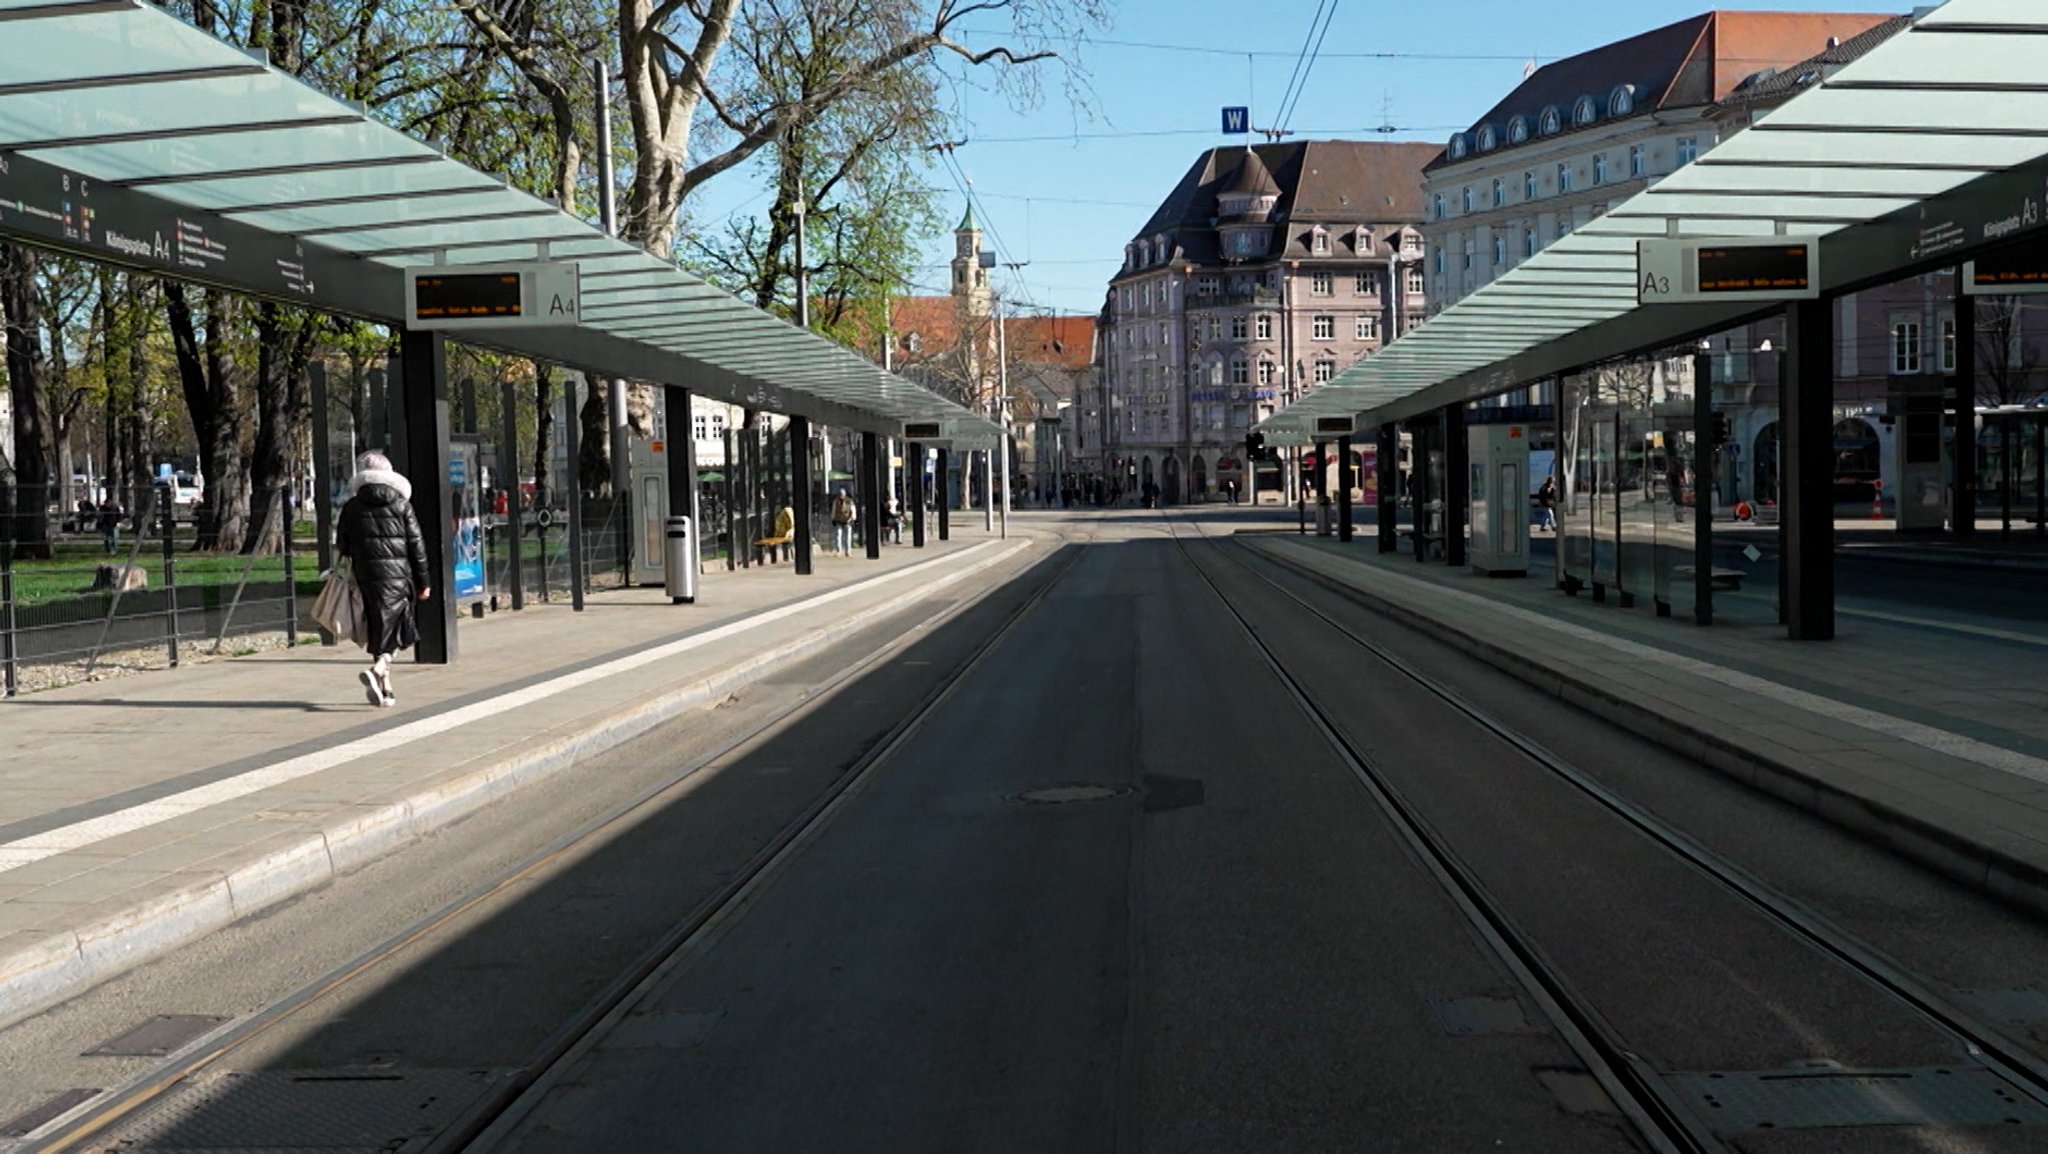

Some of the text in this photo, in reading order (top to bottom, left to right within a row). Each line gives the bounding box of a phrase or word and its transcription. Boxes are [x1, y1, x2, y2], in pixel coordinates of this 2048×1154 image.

[1227, 111, 1243, 130] W
[62, 174, 70, 192] B
[81, 180, 89, 197] C
[105, 230, 152, 257] Königsplatz
[153, 230, 170, 261] A4
[1643, 271, 1670, 294] A3
[550, 293, 574, 316] A4
